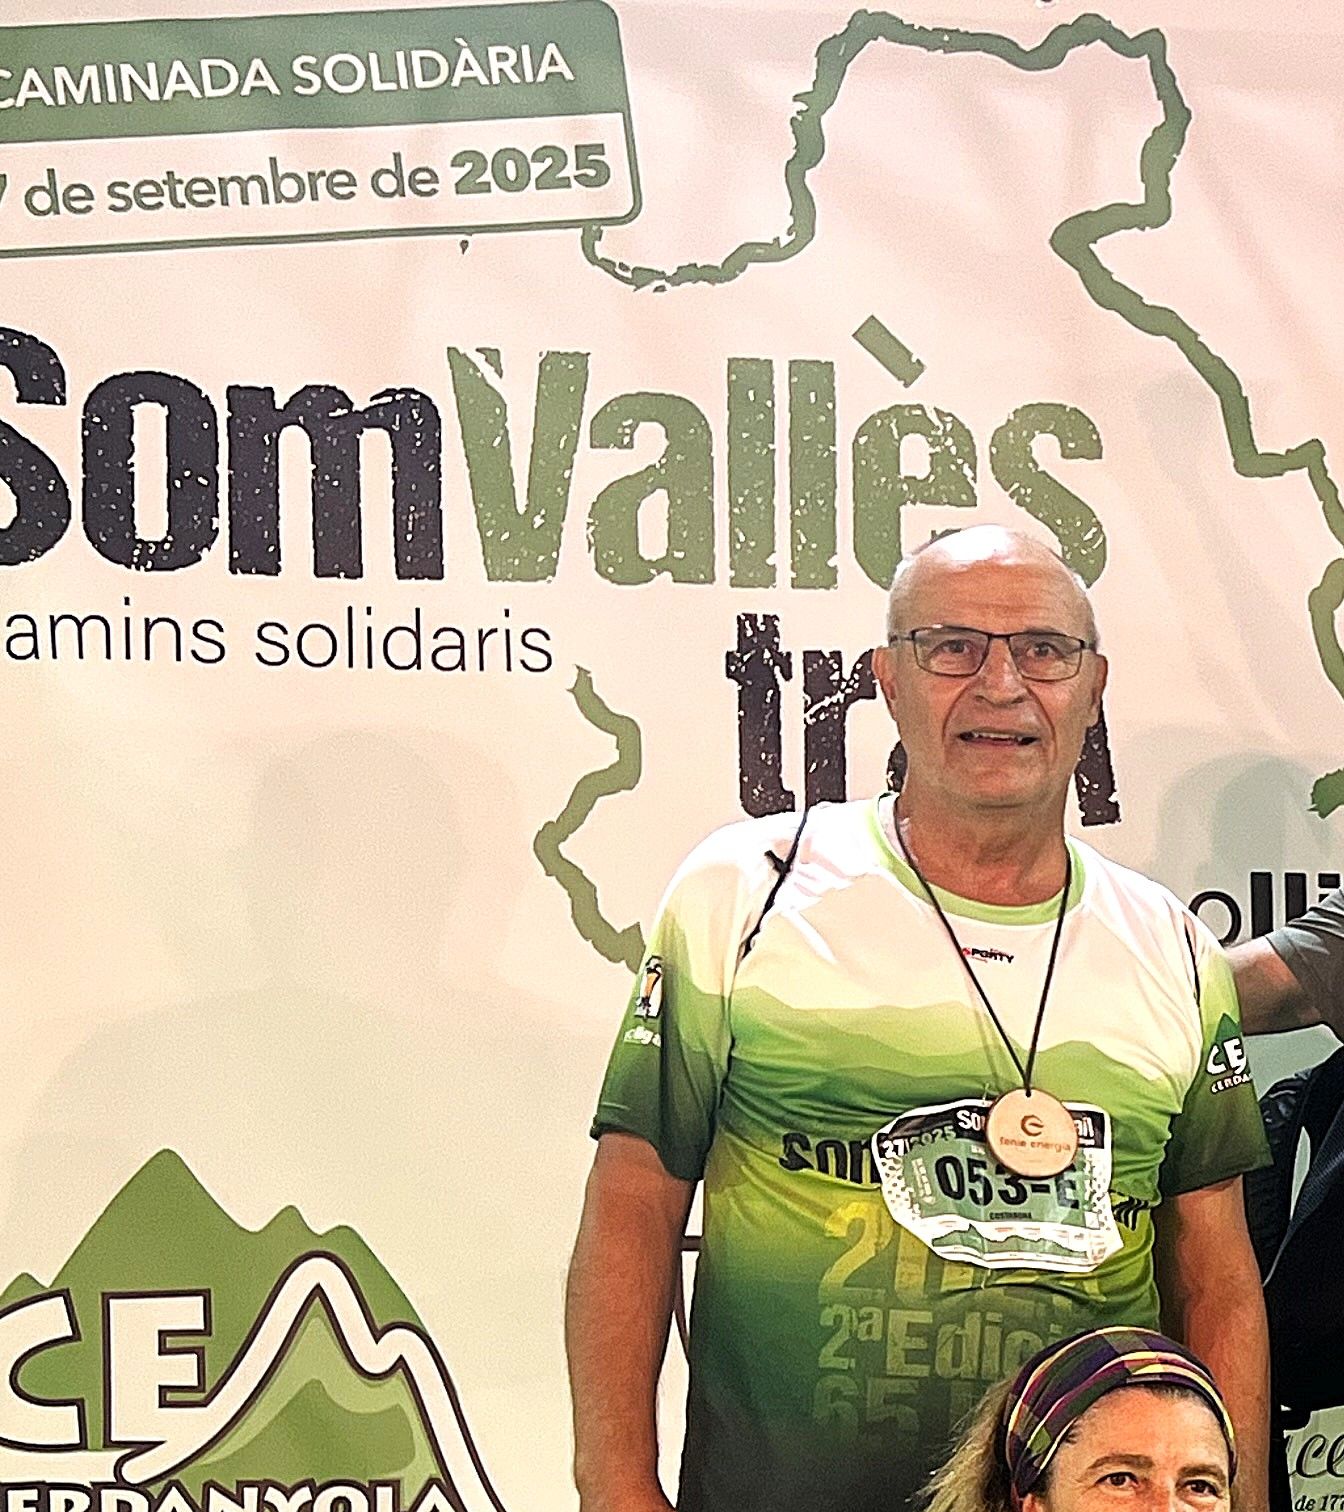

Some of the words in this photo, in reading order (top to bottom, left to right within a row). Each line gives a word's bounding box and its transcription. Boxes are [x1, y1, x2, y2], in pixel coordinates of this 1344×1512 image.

[292, 38, 574, 96] SOLIDÀRIA
[23, 167, 95, 216] de
[106, 151, 357, 213] setembre
[369, 150, 439, 198] de
[451, 143, 611, 196] 2025
[254, 606, 555, 673] solidaris
